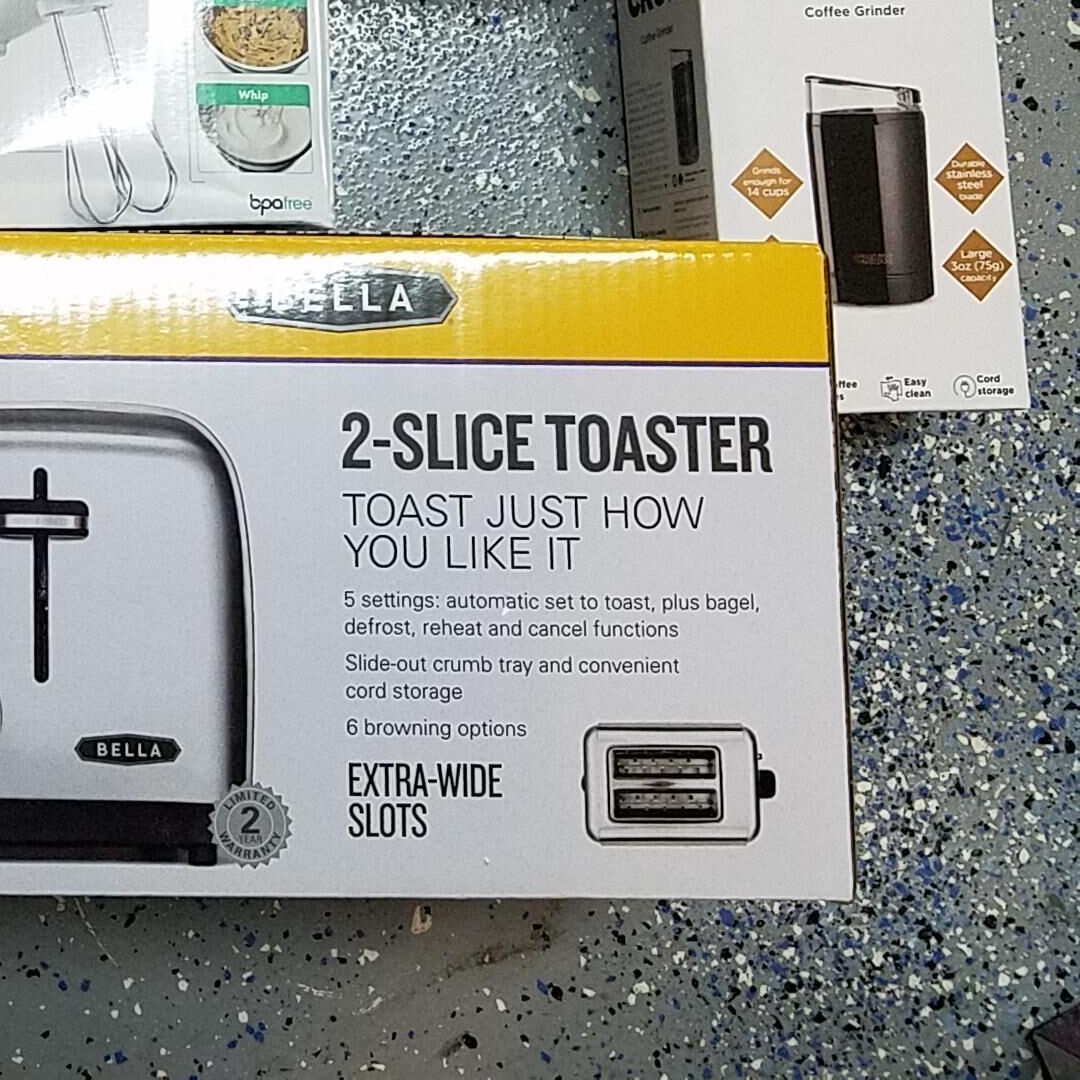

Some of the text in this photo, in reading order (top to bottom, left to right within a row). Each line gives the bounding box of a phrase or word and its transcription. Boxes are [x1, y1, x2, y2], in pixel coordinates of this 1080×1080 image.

[805, 5, 906, 18] Coffee Grinder
[239, 90, 268, 101] Whip
[960, 250, 992, 260] Large
[951, 261, 1004, 272] 3oz (75g)
[904, 378, 926, 388] Easy
[977, 374, 1000, 383] Cord
[905, 389, 931, 398] clean
[978, 386, 1014, 396] storage
[341, 411, 773, 473] 2-SLICE TOASTER
[343, 494, 704, 529] TOAST JUST HOW
[343, 535, 580, 570] YOU LIKE IT
[345, 591, 760, 615] 5 settings: automatic set to toast, plus bagel,
[97, 742, 161, 757] BELLA
[348, 763, 503, 798] EXTRA-WIDE
[349, 803, 427, 838] SLOTS
